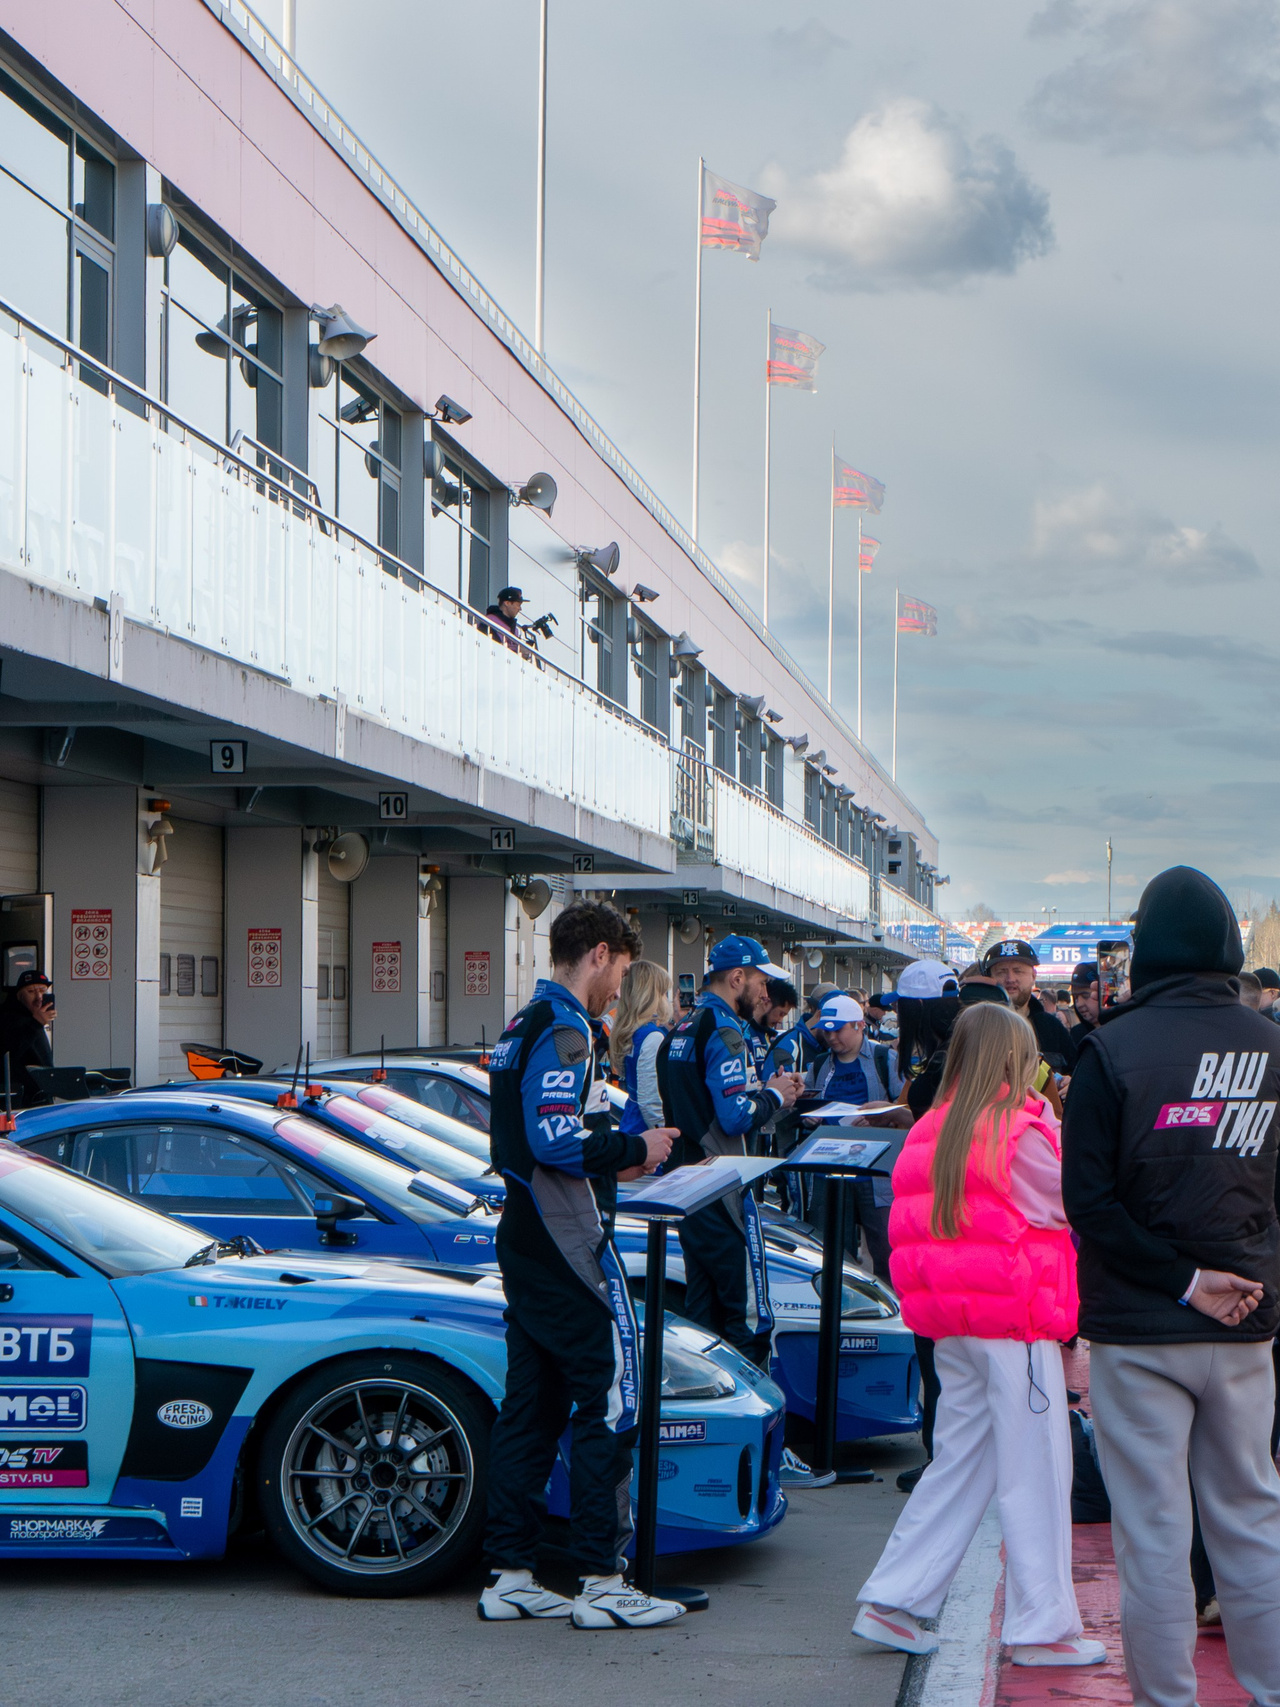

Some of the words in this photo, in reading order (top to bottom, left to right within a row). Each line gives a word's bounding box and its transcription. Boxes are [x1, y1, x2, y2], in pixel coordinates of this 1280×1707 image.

[220, 745, 235, 770] 9
[382, 796, 405, 816] 10
[493, 830, 513, 850] 11
[574, 857, 592, 872] 12
[684, 892, 698, 904] 13
[723, 904, 737, 915] 14
[756, 914, 767, 924] 15
[784, 923, 795, 933] 16
[1052, 947, 1081, 963] ВТБ
[1190, 1051, 1270, 1100] ВАШ
[542, 1091, 576, 1099] FRESH
[1165, 1105, 1214, 1125] RDS
[1211, 1101, 1278, 1158] ГИД
[0, 1327, 75, 1363] ВТБ
[610, 1278, 633, 1339] FRESH
[623, 1346, 637, 1410] RACING
[840, 1336, 878, 1349] AIMOL
[165, 1403, 206, 1416] FRESH
[163, 1413, 207, 1426] RACING
[659, 1425, 705, 1439] AIMOL
[32, 1447, 64, 1464] TV
[10, 1519, 94, 1531] SHOPMARKA
[10, 1528, 64, 1541] motorsport
[64, 1527, 98, 1540] design
[616, 1598, 652, 1608] sparco
